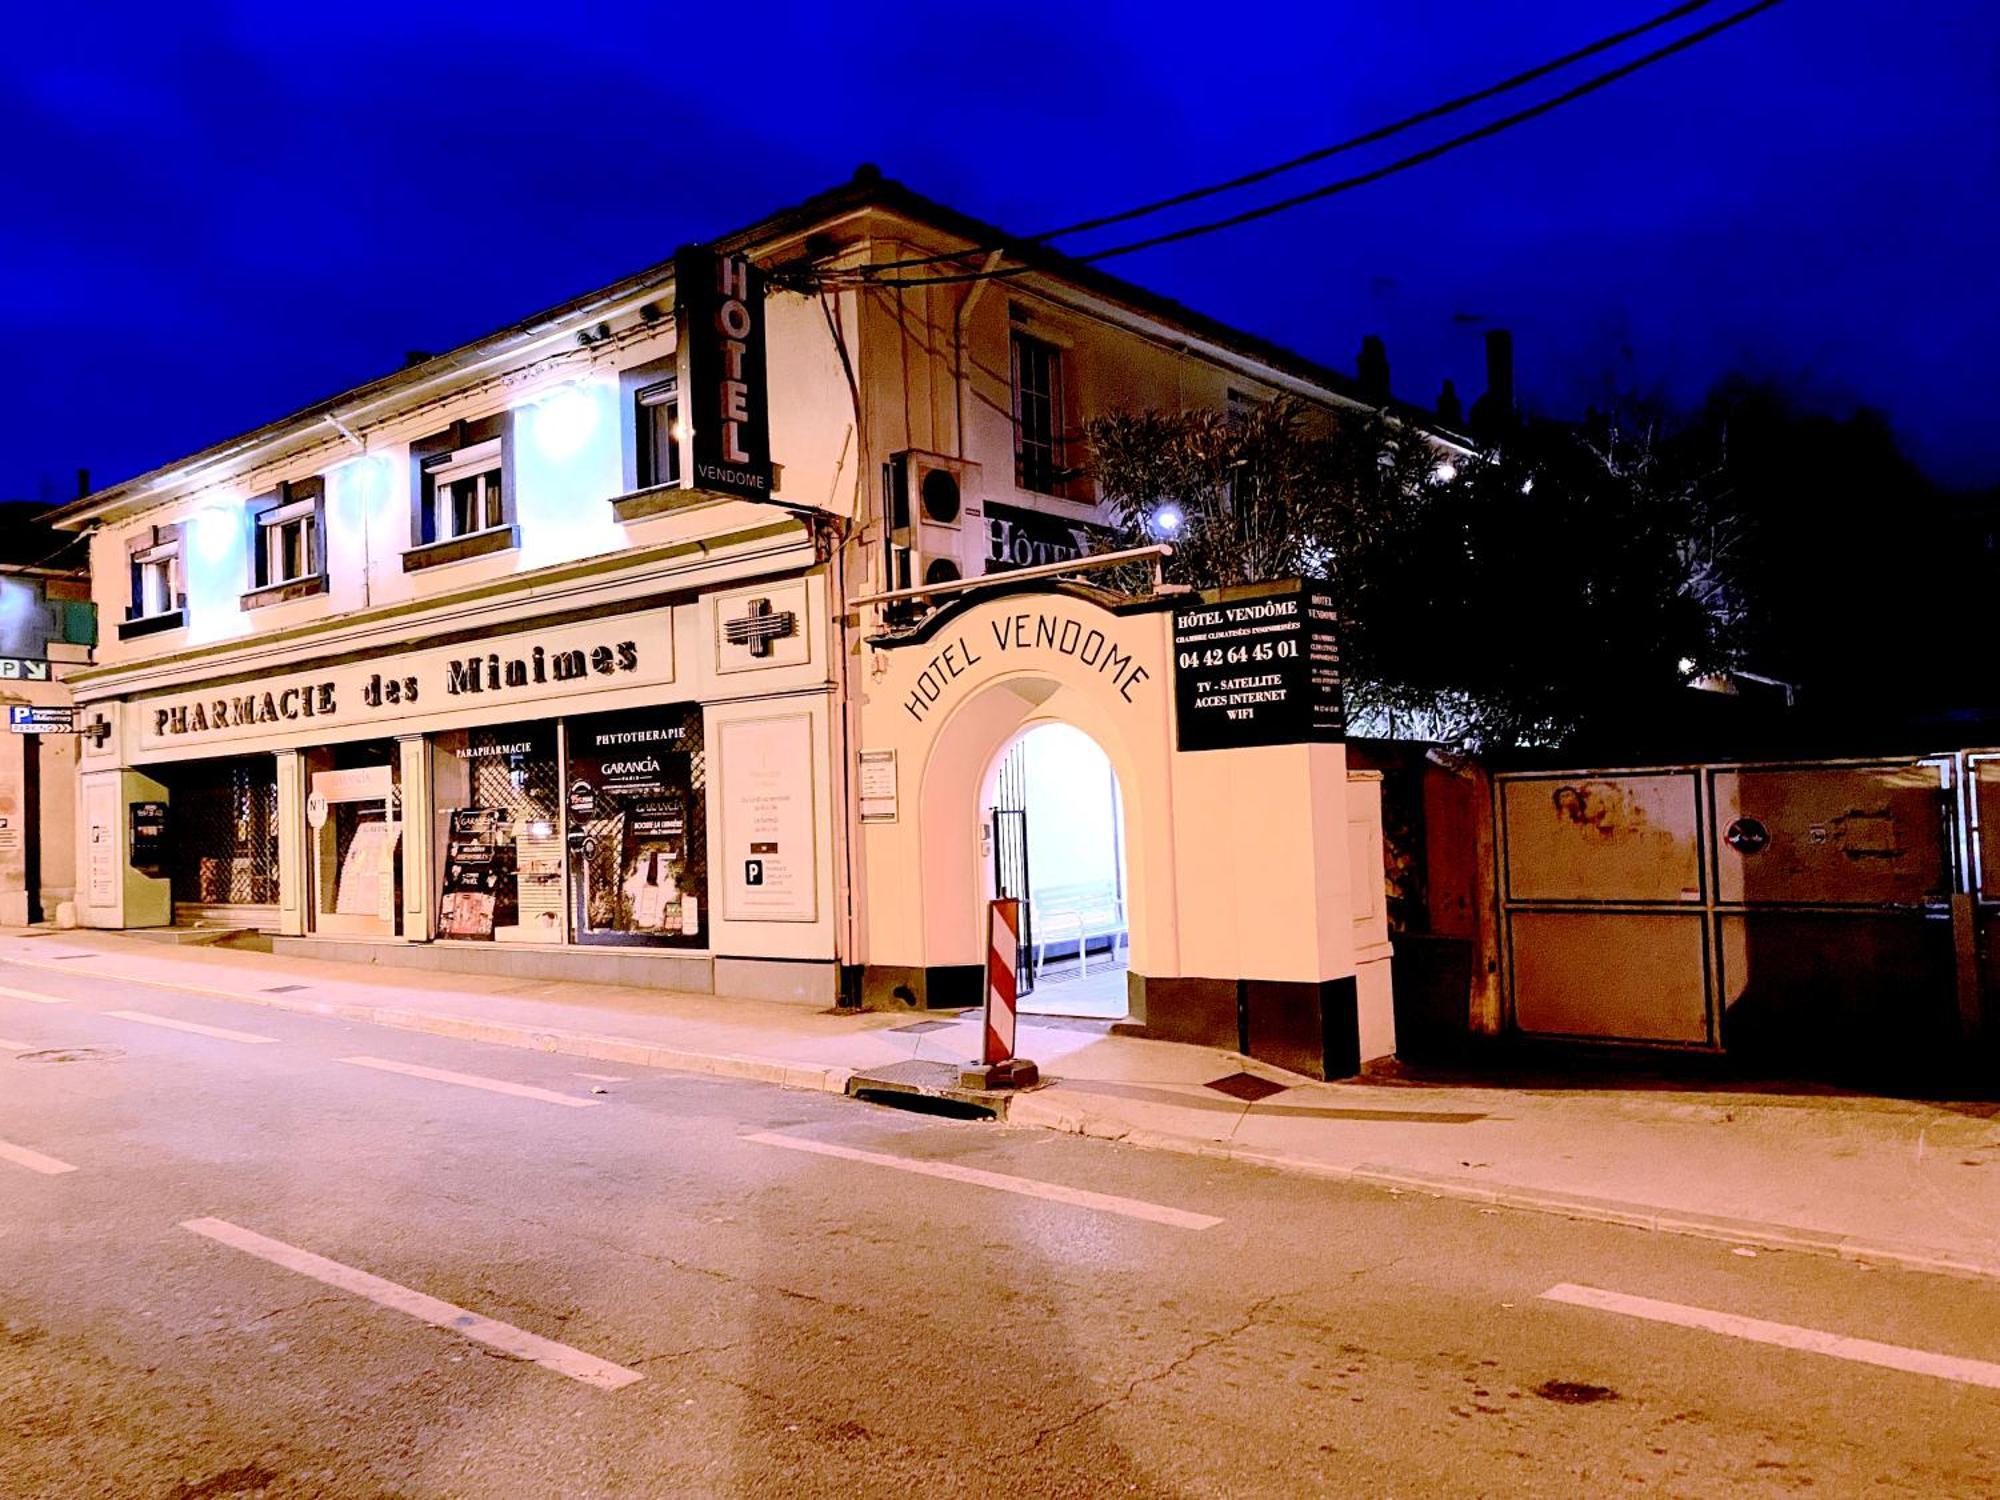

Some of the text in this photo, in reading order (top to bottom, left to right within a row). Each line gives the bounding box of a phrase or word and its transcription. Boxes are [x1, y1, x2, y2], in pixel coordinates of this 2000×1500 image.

[717, 256, 751, 464] HOTEL
[698, 463, 765, 489] VENDOME
[1178, 601, 1297, 628] HÔTEL VENDÔME
[1180, 640, 1298, 668] 04 42 64 45 01
[904, 614, 1150, 722] HOTEL VENDOME
[153, 640, 639, 736] PHARMACIE des Minimes
[1197, 681, 1212, 693] TV
[1221, 675, 1281, 690] SATELLITE
[1195, 690, 1286, 708] ACCES INTERNET
[1227, 709, 1254, 719] WIFI
[595, 727, 687, 746] PHYTOTHERAPIE
[456, 742, 532, 758] PARAPHARMACIE
